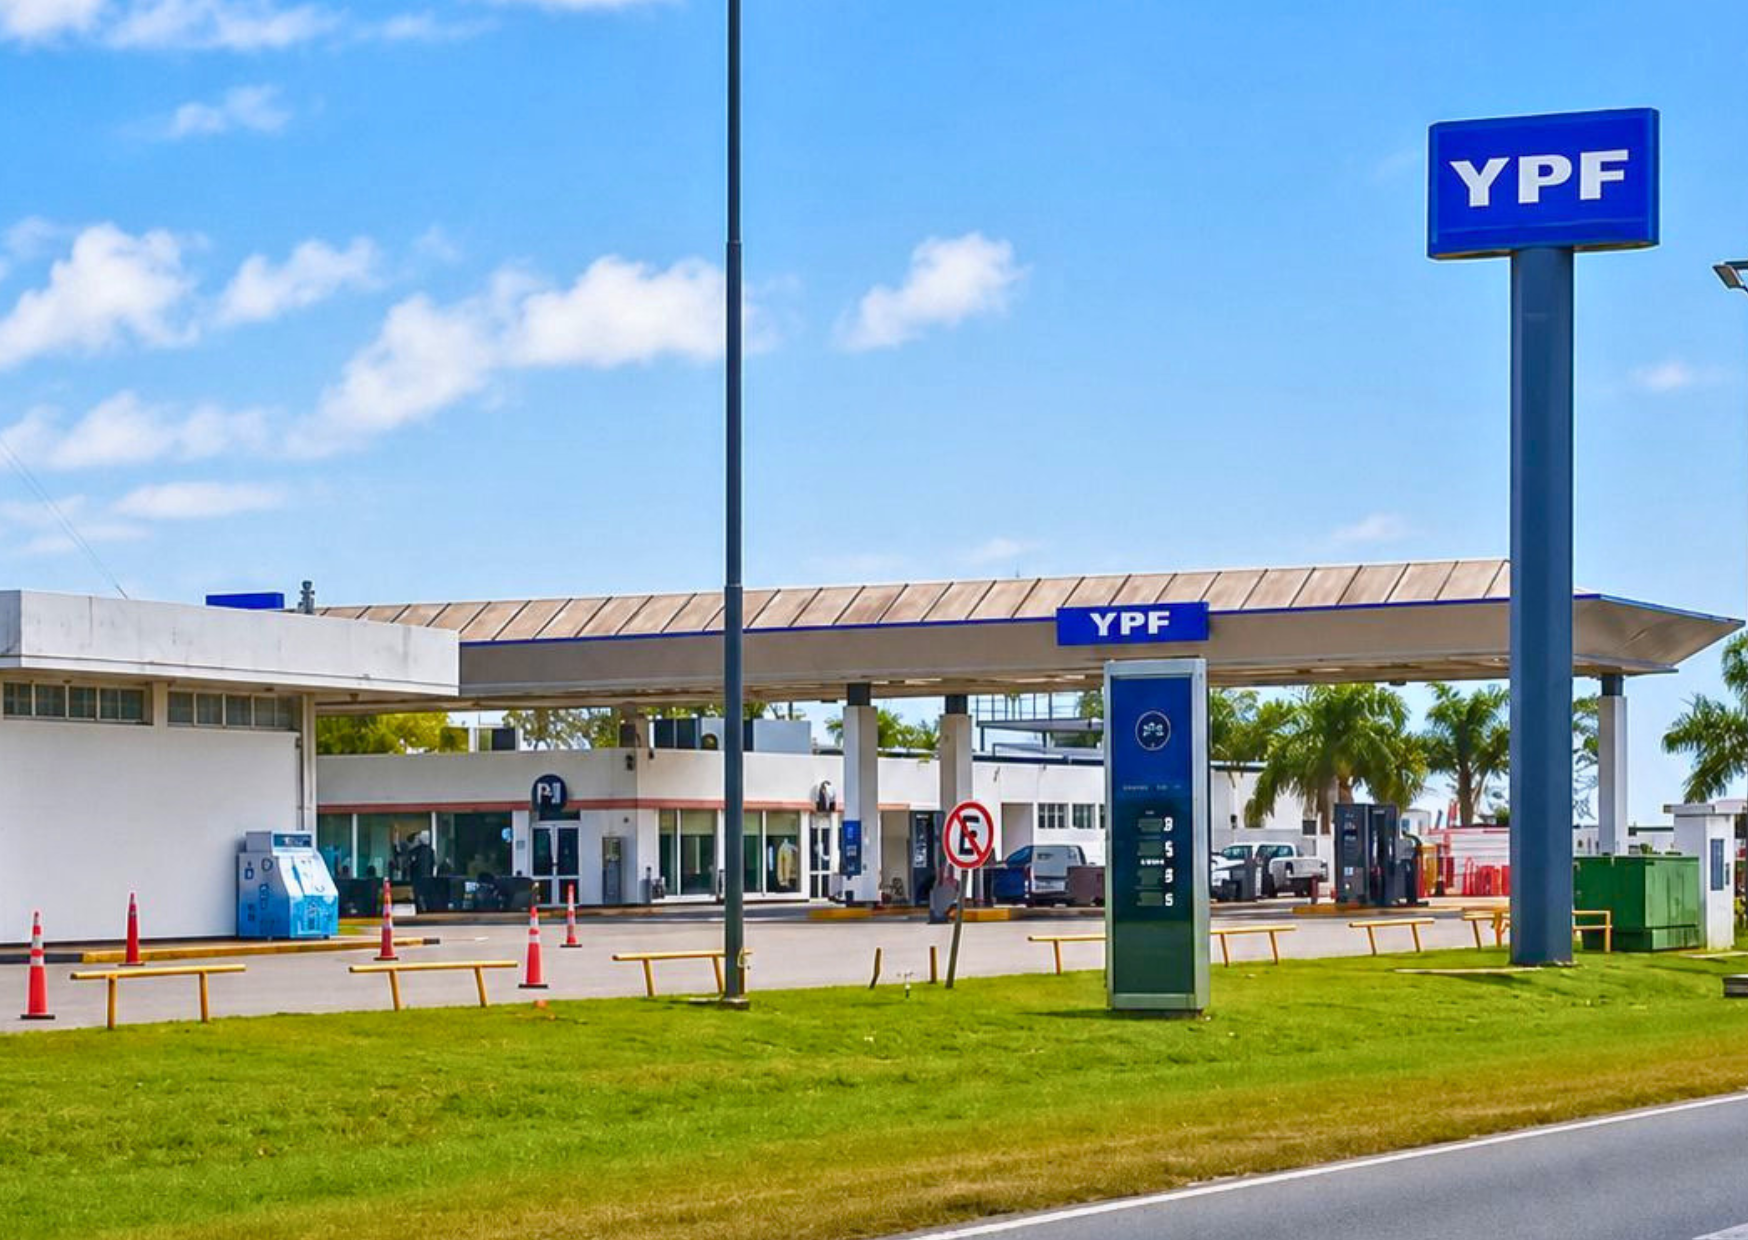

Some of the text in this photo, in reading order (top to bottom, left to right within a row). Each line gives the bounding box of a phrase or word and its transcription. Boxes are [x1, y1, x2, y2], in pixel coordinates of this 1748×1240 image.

[1449, 149, 1629, 207] YPF
[1089, 611, 1170, 636] YPF
[959, 815, 980, 855] E
